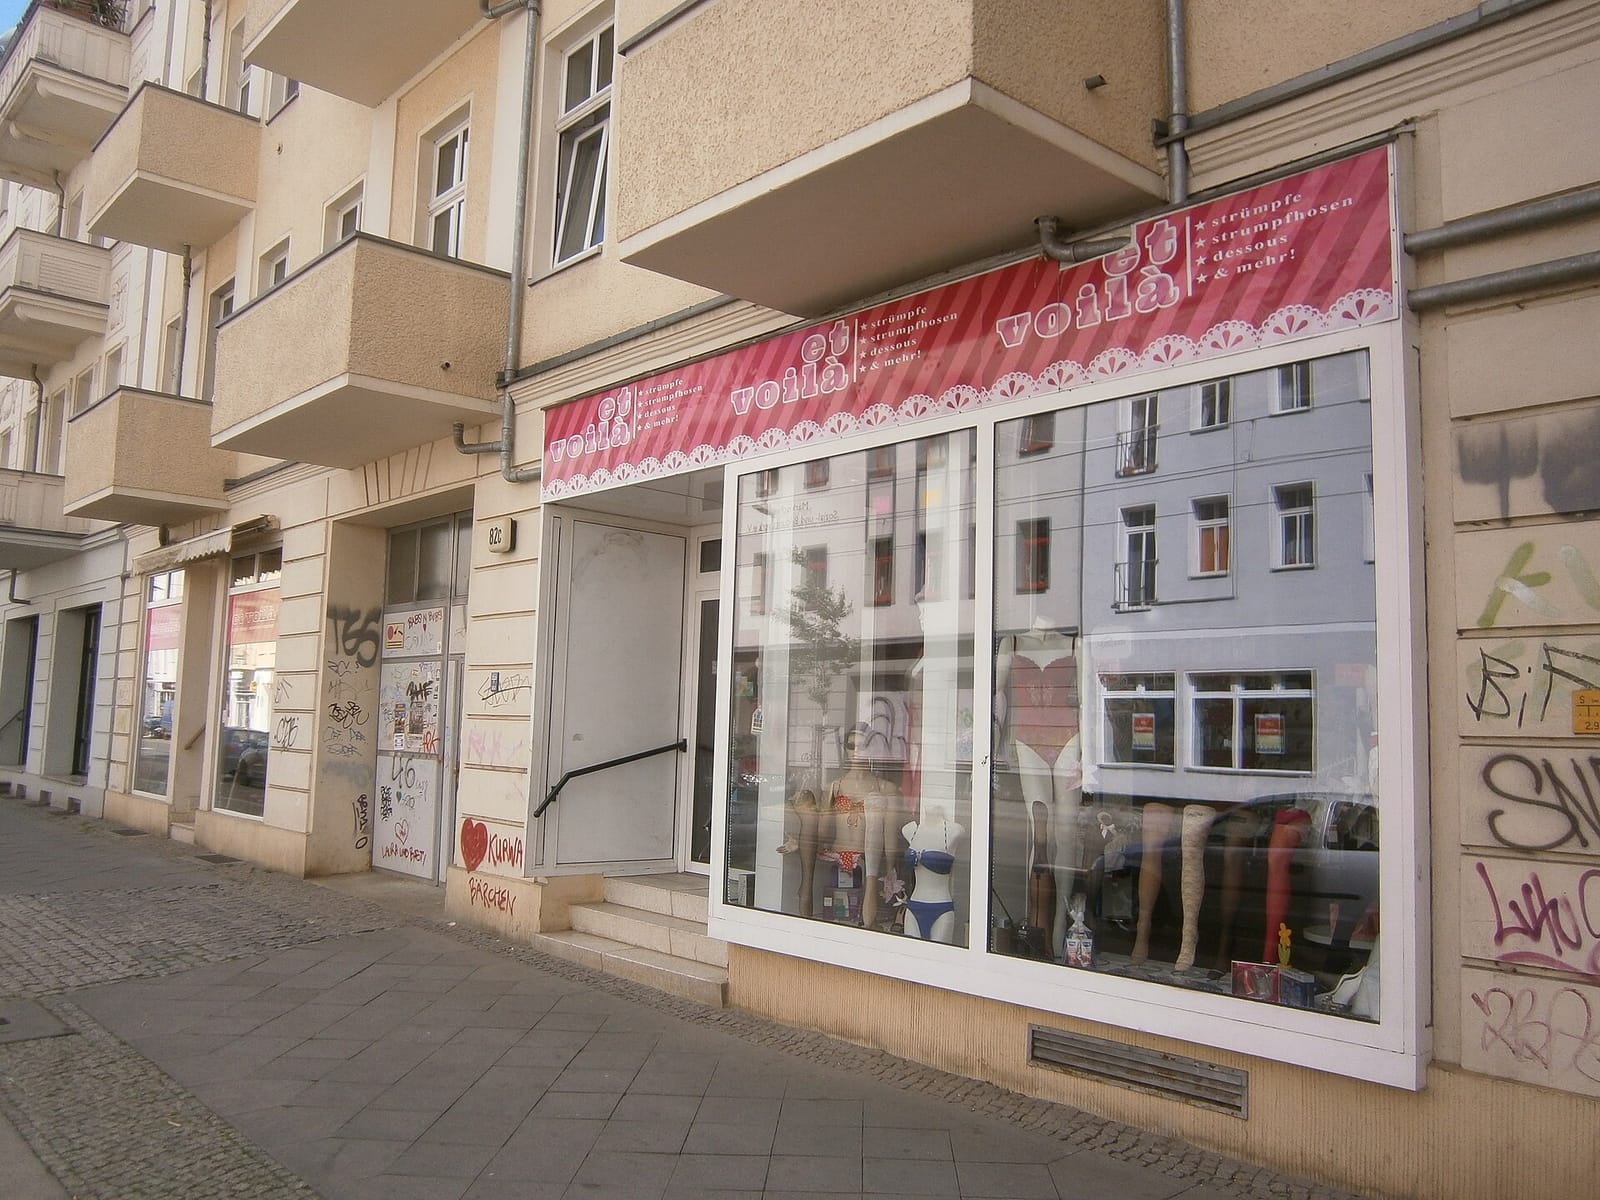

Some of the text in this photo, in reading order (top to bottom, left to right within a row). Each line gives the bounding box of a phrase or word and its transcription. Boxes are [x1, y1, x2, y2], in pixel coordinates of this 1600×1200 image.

[1211, 192, 1303, 228] strümpfe
[1211, 196, 1354, 245] strumpfhosen
[1102, 217, 1178, 277] et
[1212, 234, 1289, 263] dessous
[1213, 248, 1297, 280] & mehr!
[870, 305, 928, 329] strümpfe
[996, 265, 1180, 348] voilà
[801, 319, 850, 363] et
[869, 311, 958, 343] strumpfhosen
[869, 339, 918, 358] dessous
[883, 349, 922, 367] mehr!
[644, 383, 703, 408] strumpfhosen
[730, 356, 849, 415] voilà
[598, 386, 632, 422] et
[644, 404, 676, 418] dessous
[654, 414, 679, 427] mehr!
[549, 416, 630, 463] voilà
[488, 833, 523, 868] KURWA
[469, 877, 516, 916] BÄRCHEN
